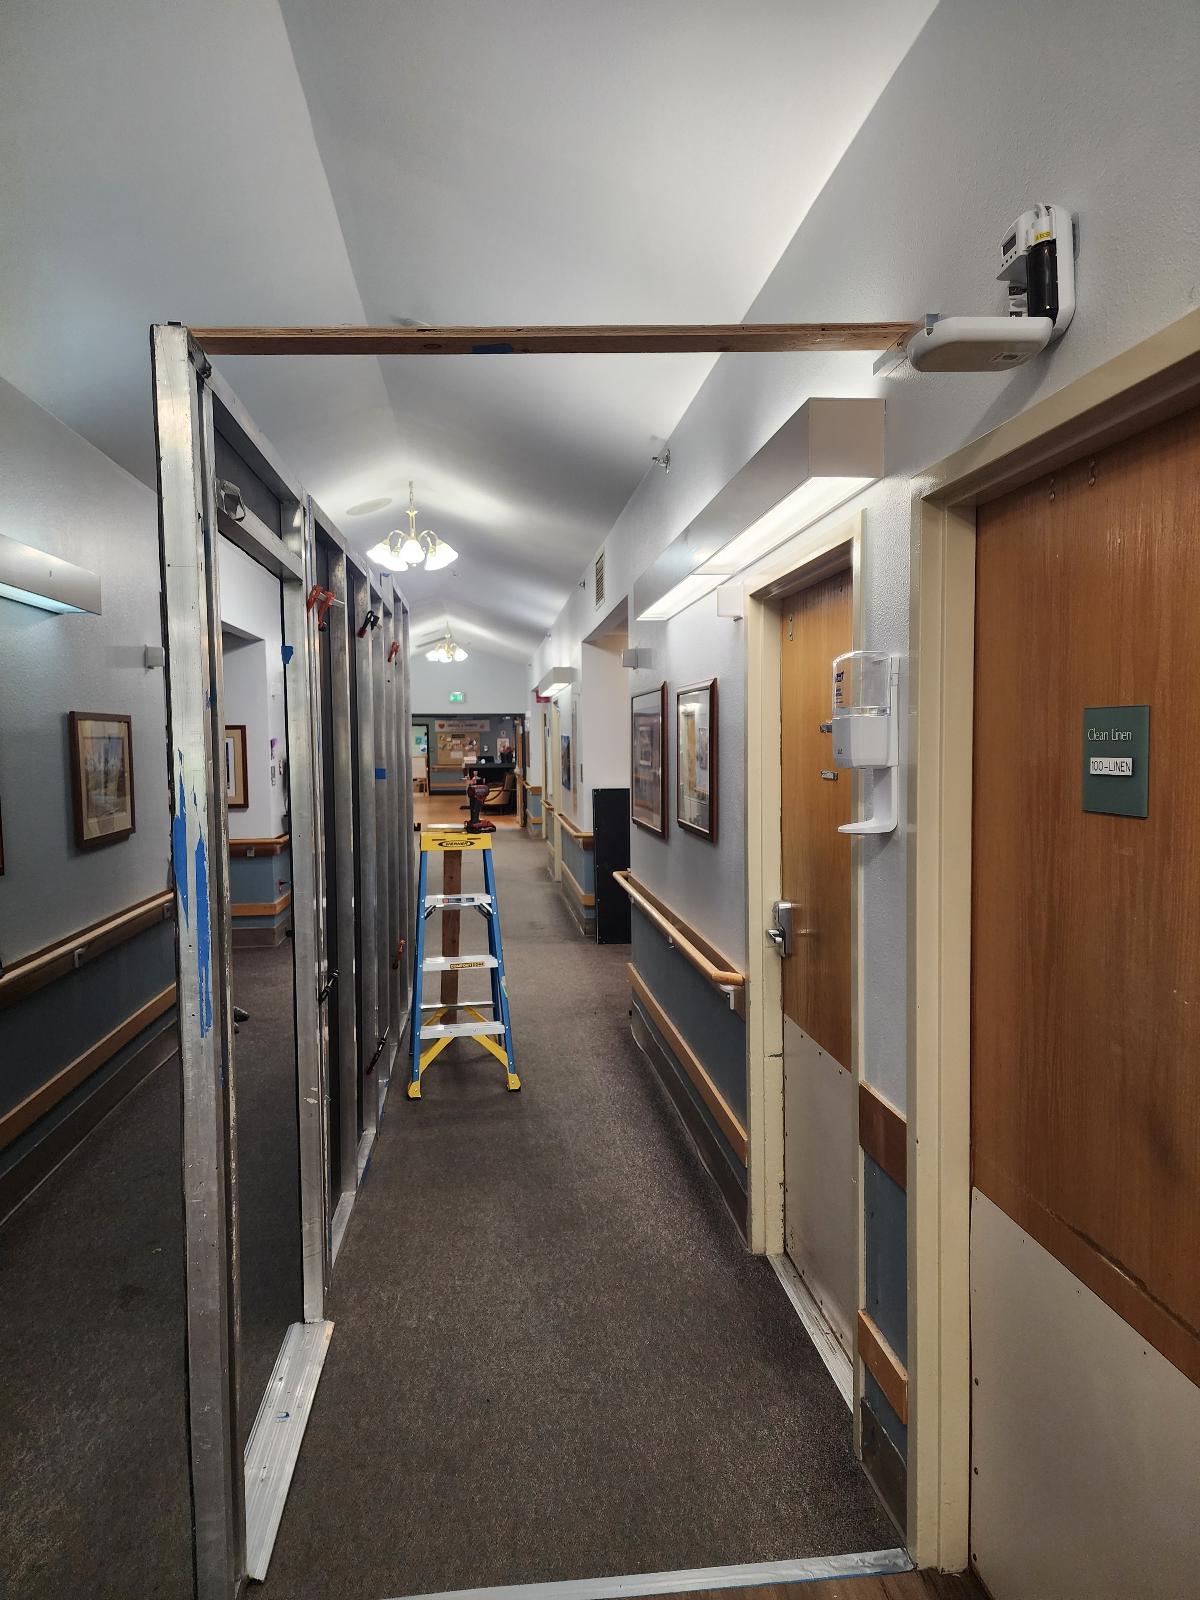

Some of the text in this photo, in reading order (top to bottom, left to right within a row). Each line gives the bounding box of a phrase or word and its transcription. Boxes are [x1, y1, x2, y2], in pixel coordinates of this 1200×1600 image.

[1088, 727, 1132, 741] Clean Linen
[1091, 760, 1131, 773] 100-LINEN
